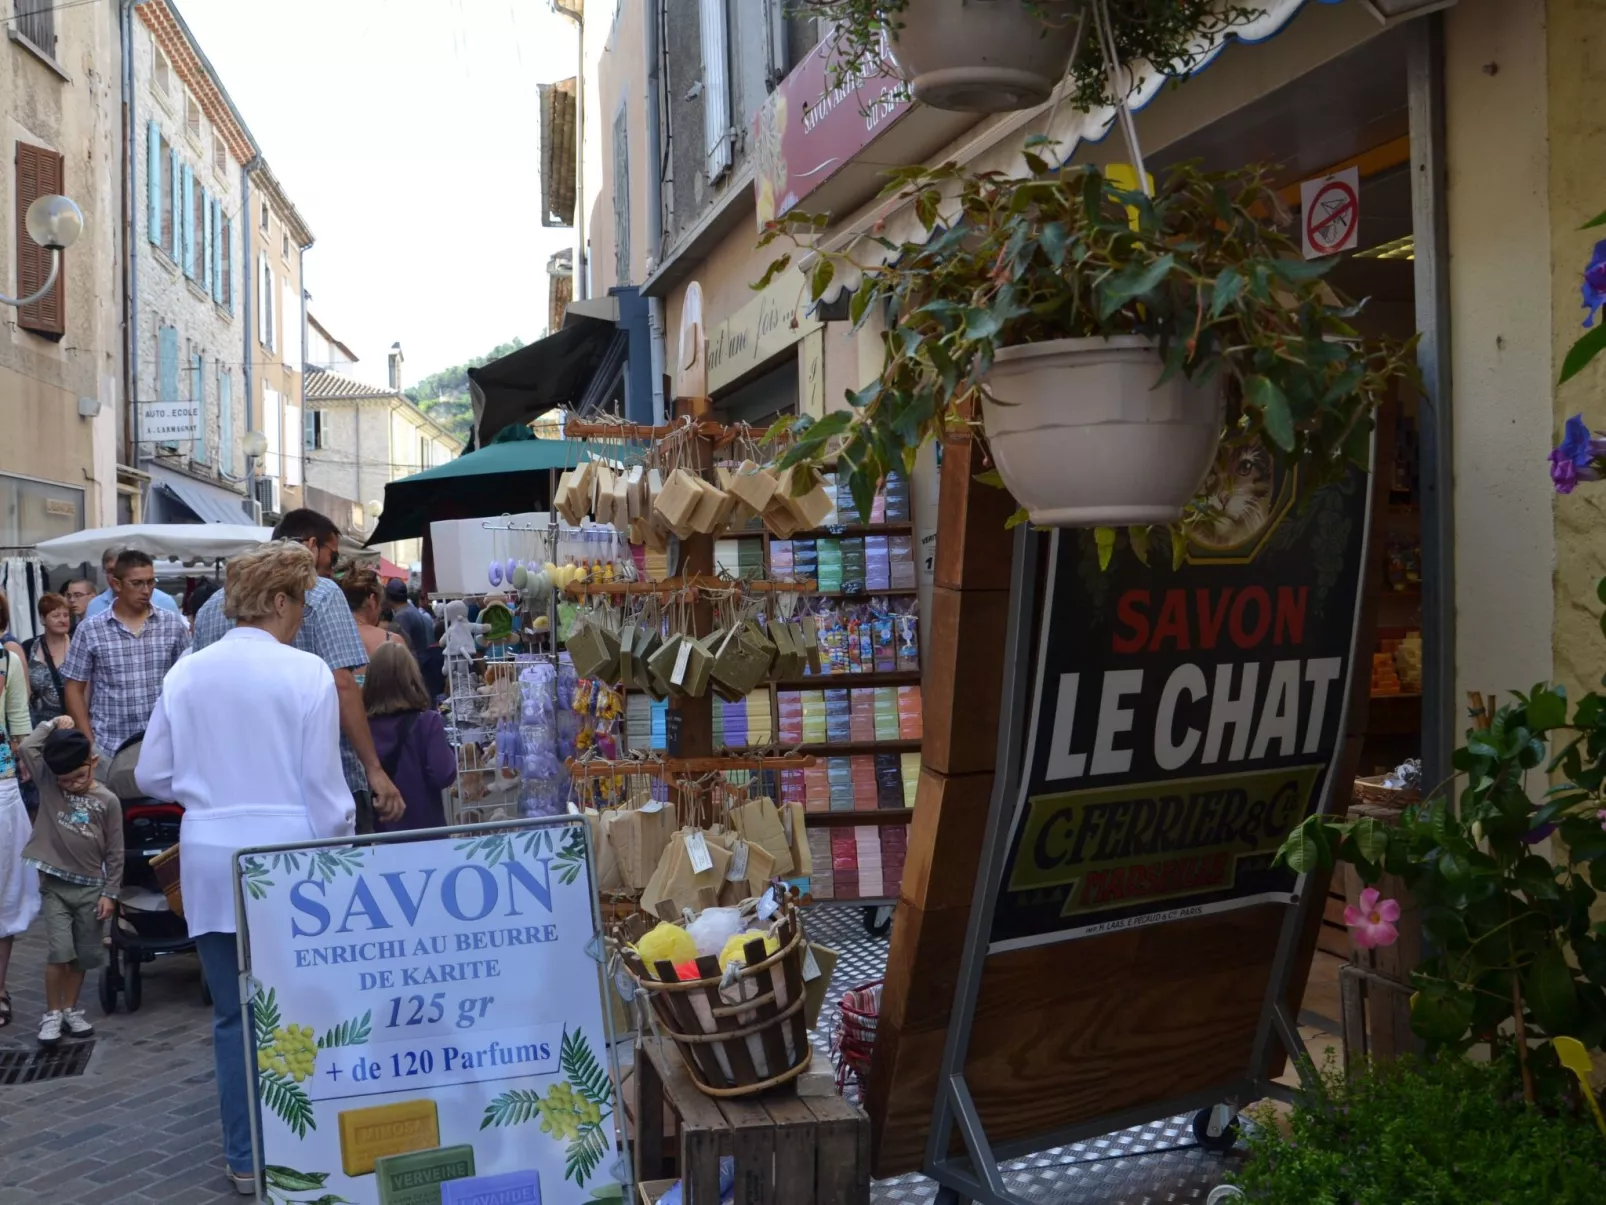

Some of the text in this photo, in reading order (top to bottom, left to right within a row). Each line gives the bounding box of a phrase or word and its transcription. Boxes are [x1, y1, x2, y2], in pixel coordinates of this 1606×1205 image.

[1112, 585, 1310, 654] SAVON
[1045, 657, 1342, 781] LE CHAT
[289, 857, 555, 939] SAVON
[294, 924, 559, 968] ENRICHI AU BEURRE
[359, 959, 501, 991] DE KARITE
[385, 992, 495, 1030] 125 gr
[352, 1056, 381, 1083] de
[390, 1050, 434, 1078] 120
[441, 1040, 551, 1073] Parfums
[363, 1120, 425, 1142] MIMOSA
[393, 1162, 466, 1187] VERVEINE
